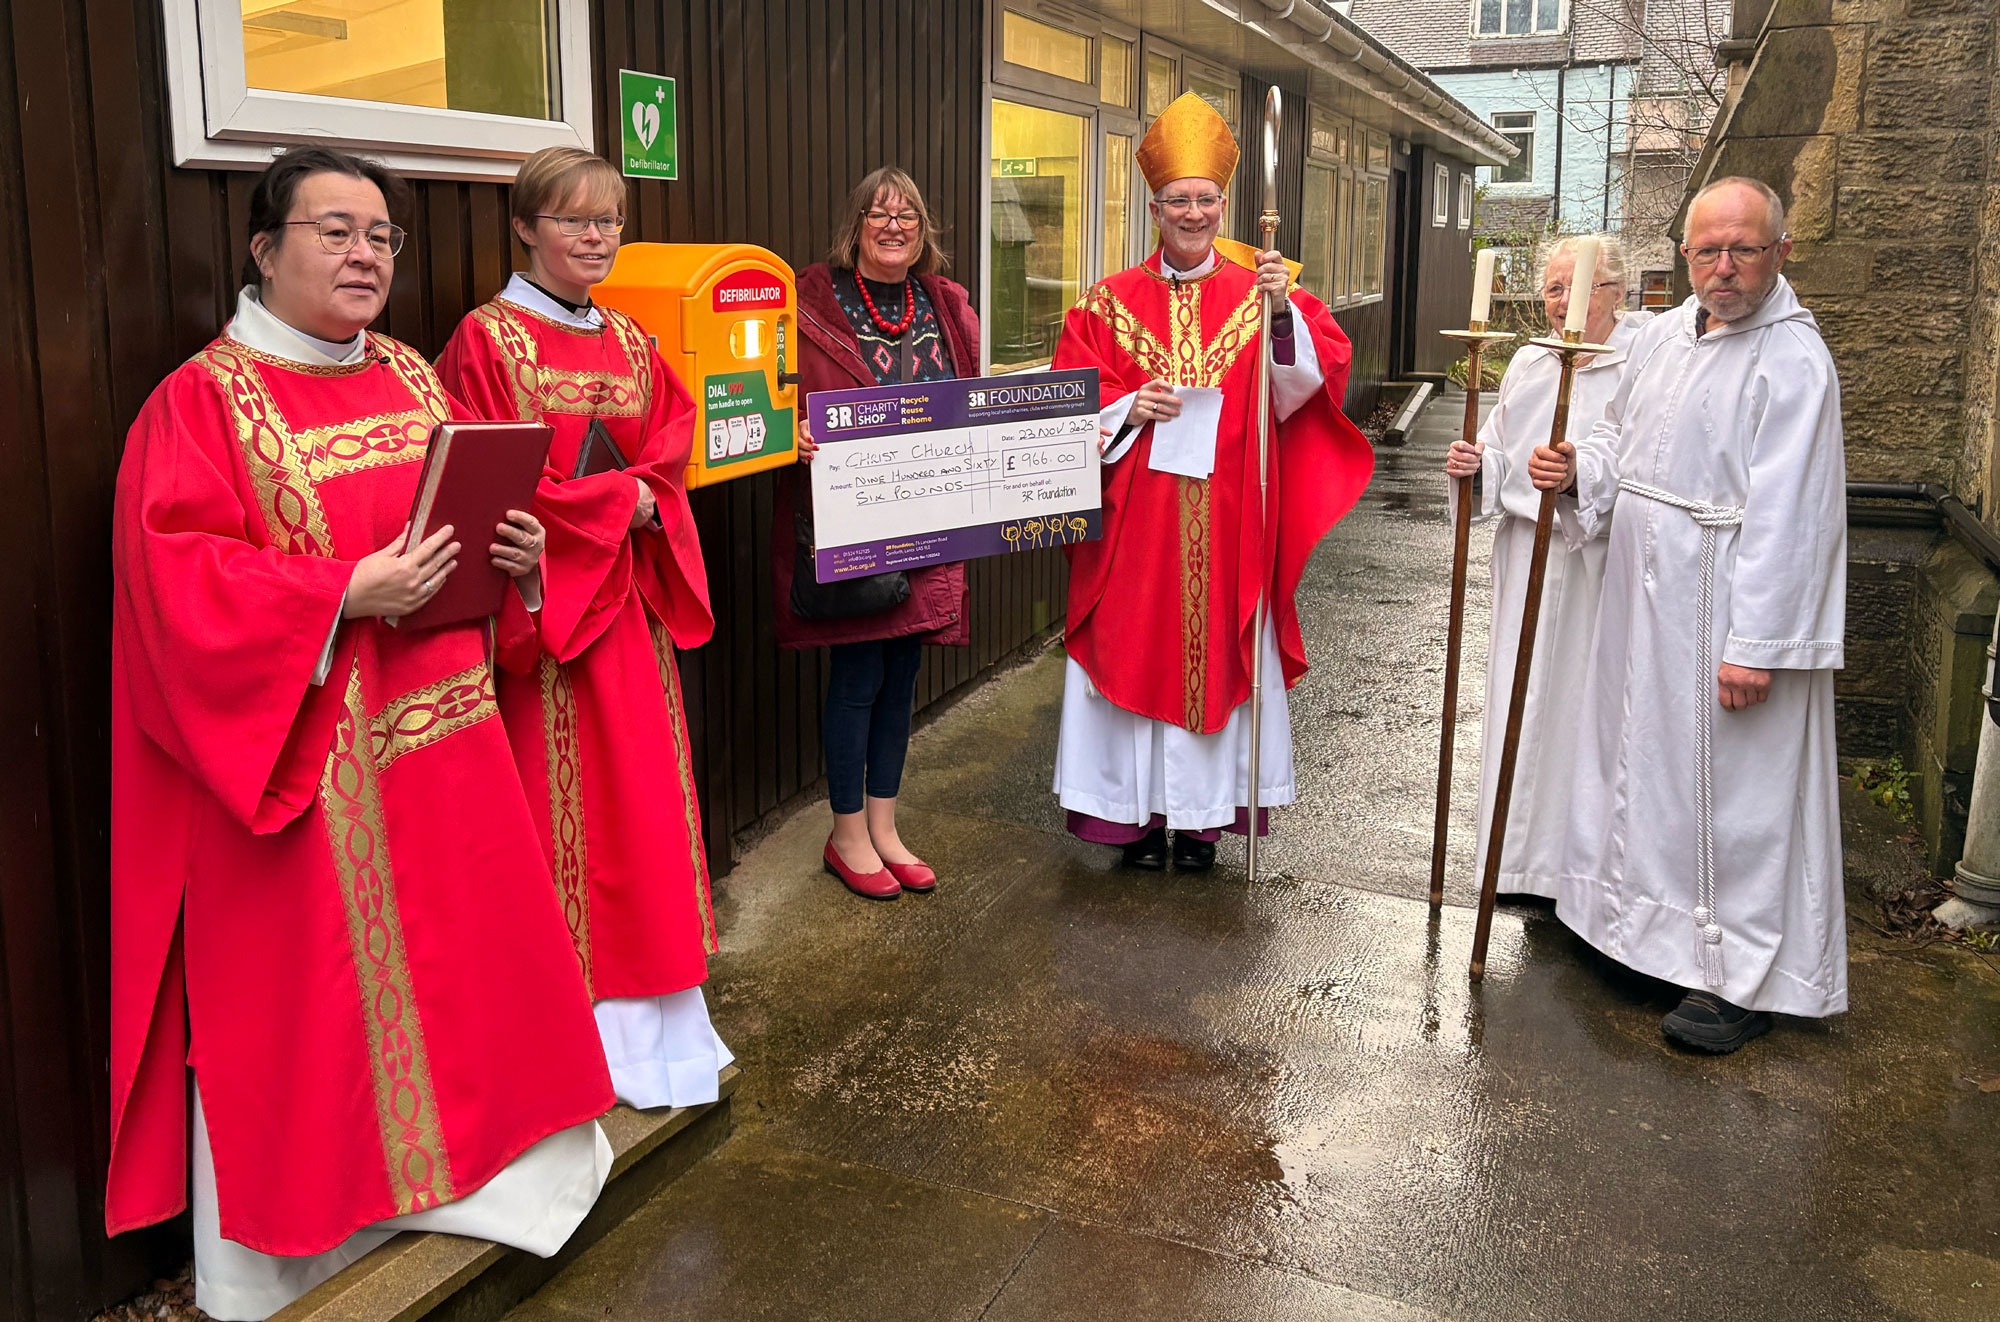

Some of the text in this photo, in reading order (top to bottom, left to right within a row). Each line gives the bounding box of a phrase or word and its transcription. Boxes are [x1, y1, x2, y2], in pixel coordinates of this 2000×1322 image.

[630, 158, 670, 171] Defibrillator
[720, 287, 780, 303] DEFIBRILLATOR
[708, 382, 744, 398] DIAL 999
[968, 382, 1086, 407] 3R FOUNDATION
[718, 400, 734, 409] handle
[741, 398, 753, 407] open
[900, 395, 930, 405] Recycle
[857, 402, 899, 414] CHARITY
[901, 406, 924, 415] Reuse
[826, 406, 853, 429] 3R
[858, 414, 886, 426] SHOP
[902, 416, 932, 425] Rehome
[1019, 429, 1036, 440] 23
[1069, 419, 1094, 434] 2025
[845, 443, 974, 468] CHRIST CHURCH
[829, 464, 840, 472] Pay:
[856, 475, 886, 488] NINE
[1022, 486, 1076, 502] 3R Foundation
[834, 562, 876, 574] www.3rc.org.uk
